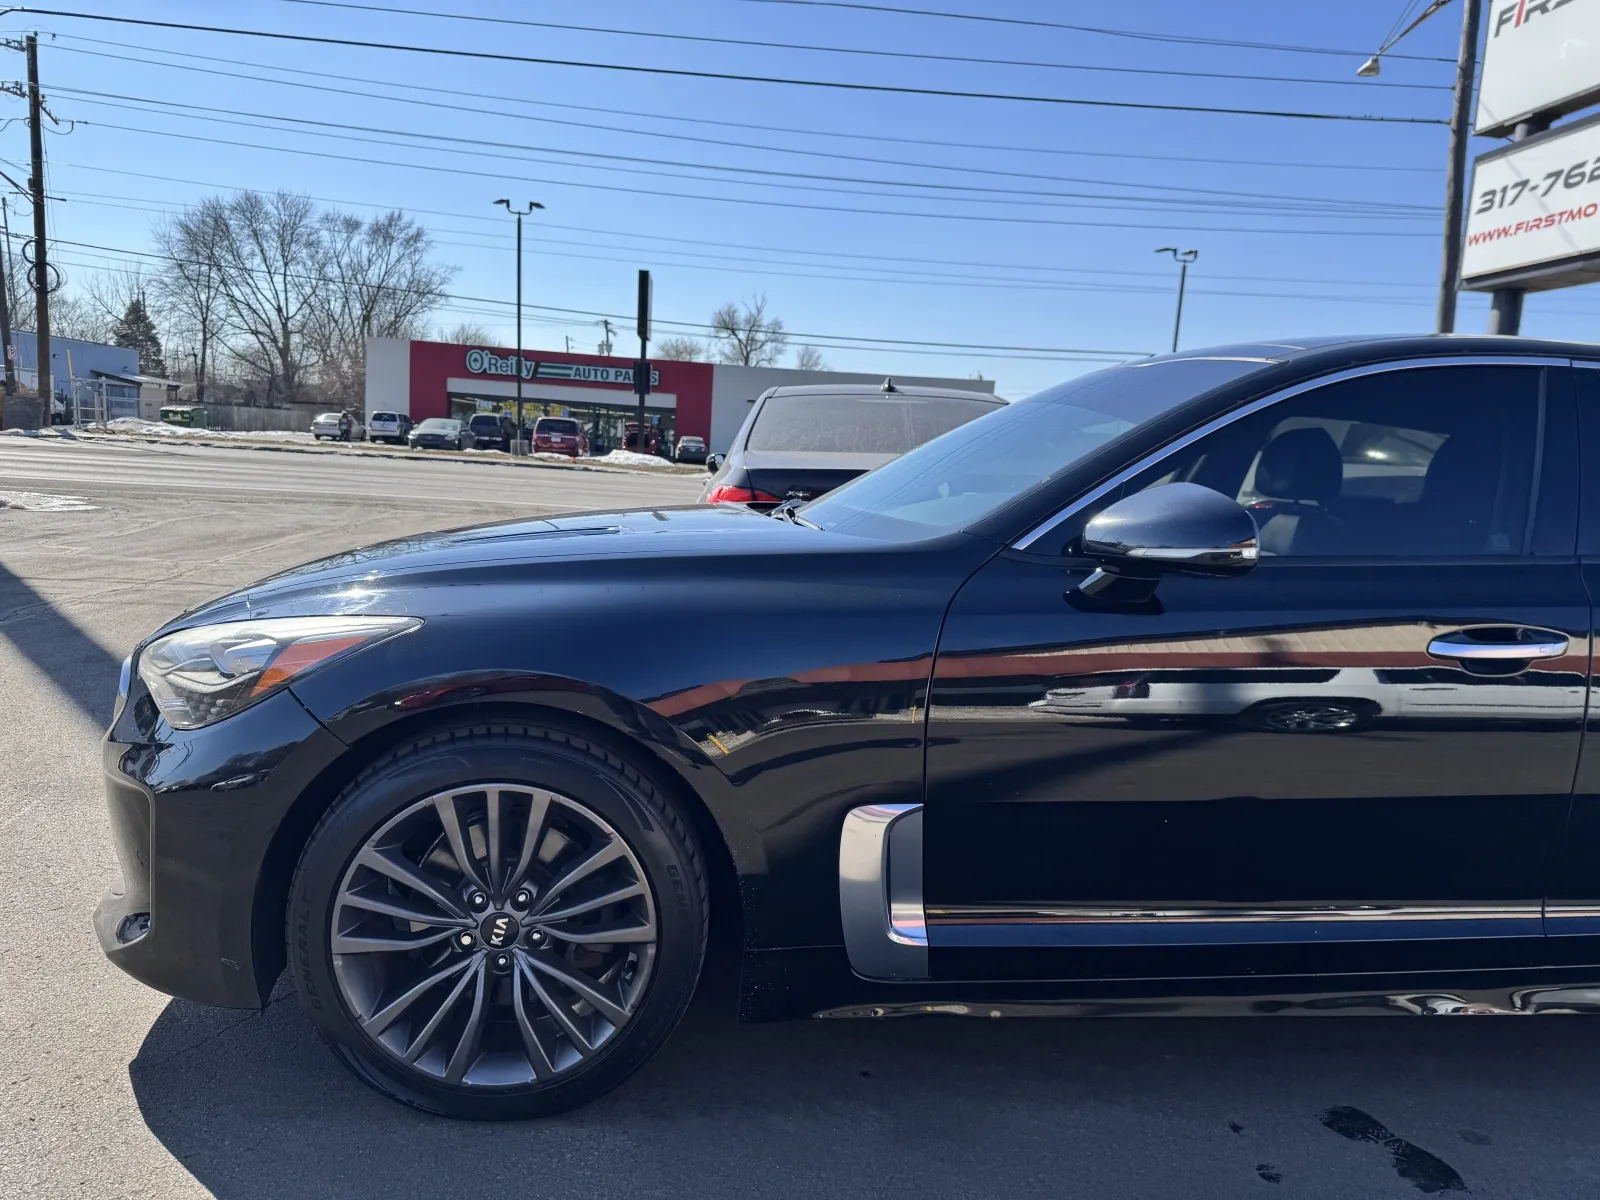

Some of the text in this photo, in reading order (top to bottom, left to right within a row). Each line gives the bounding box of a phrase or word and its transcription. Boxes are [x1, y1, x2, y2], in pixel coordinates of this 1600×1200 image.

[573, 366, 609, 381] AUTO
[614, 369, 657, 384] PAS
[490, 917, 510, 946] KIA
[297, 908, 325, 1012] GENERAL
